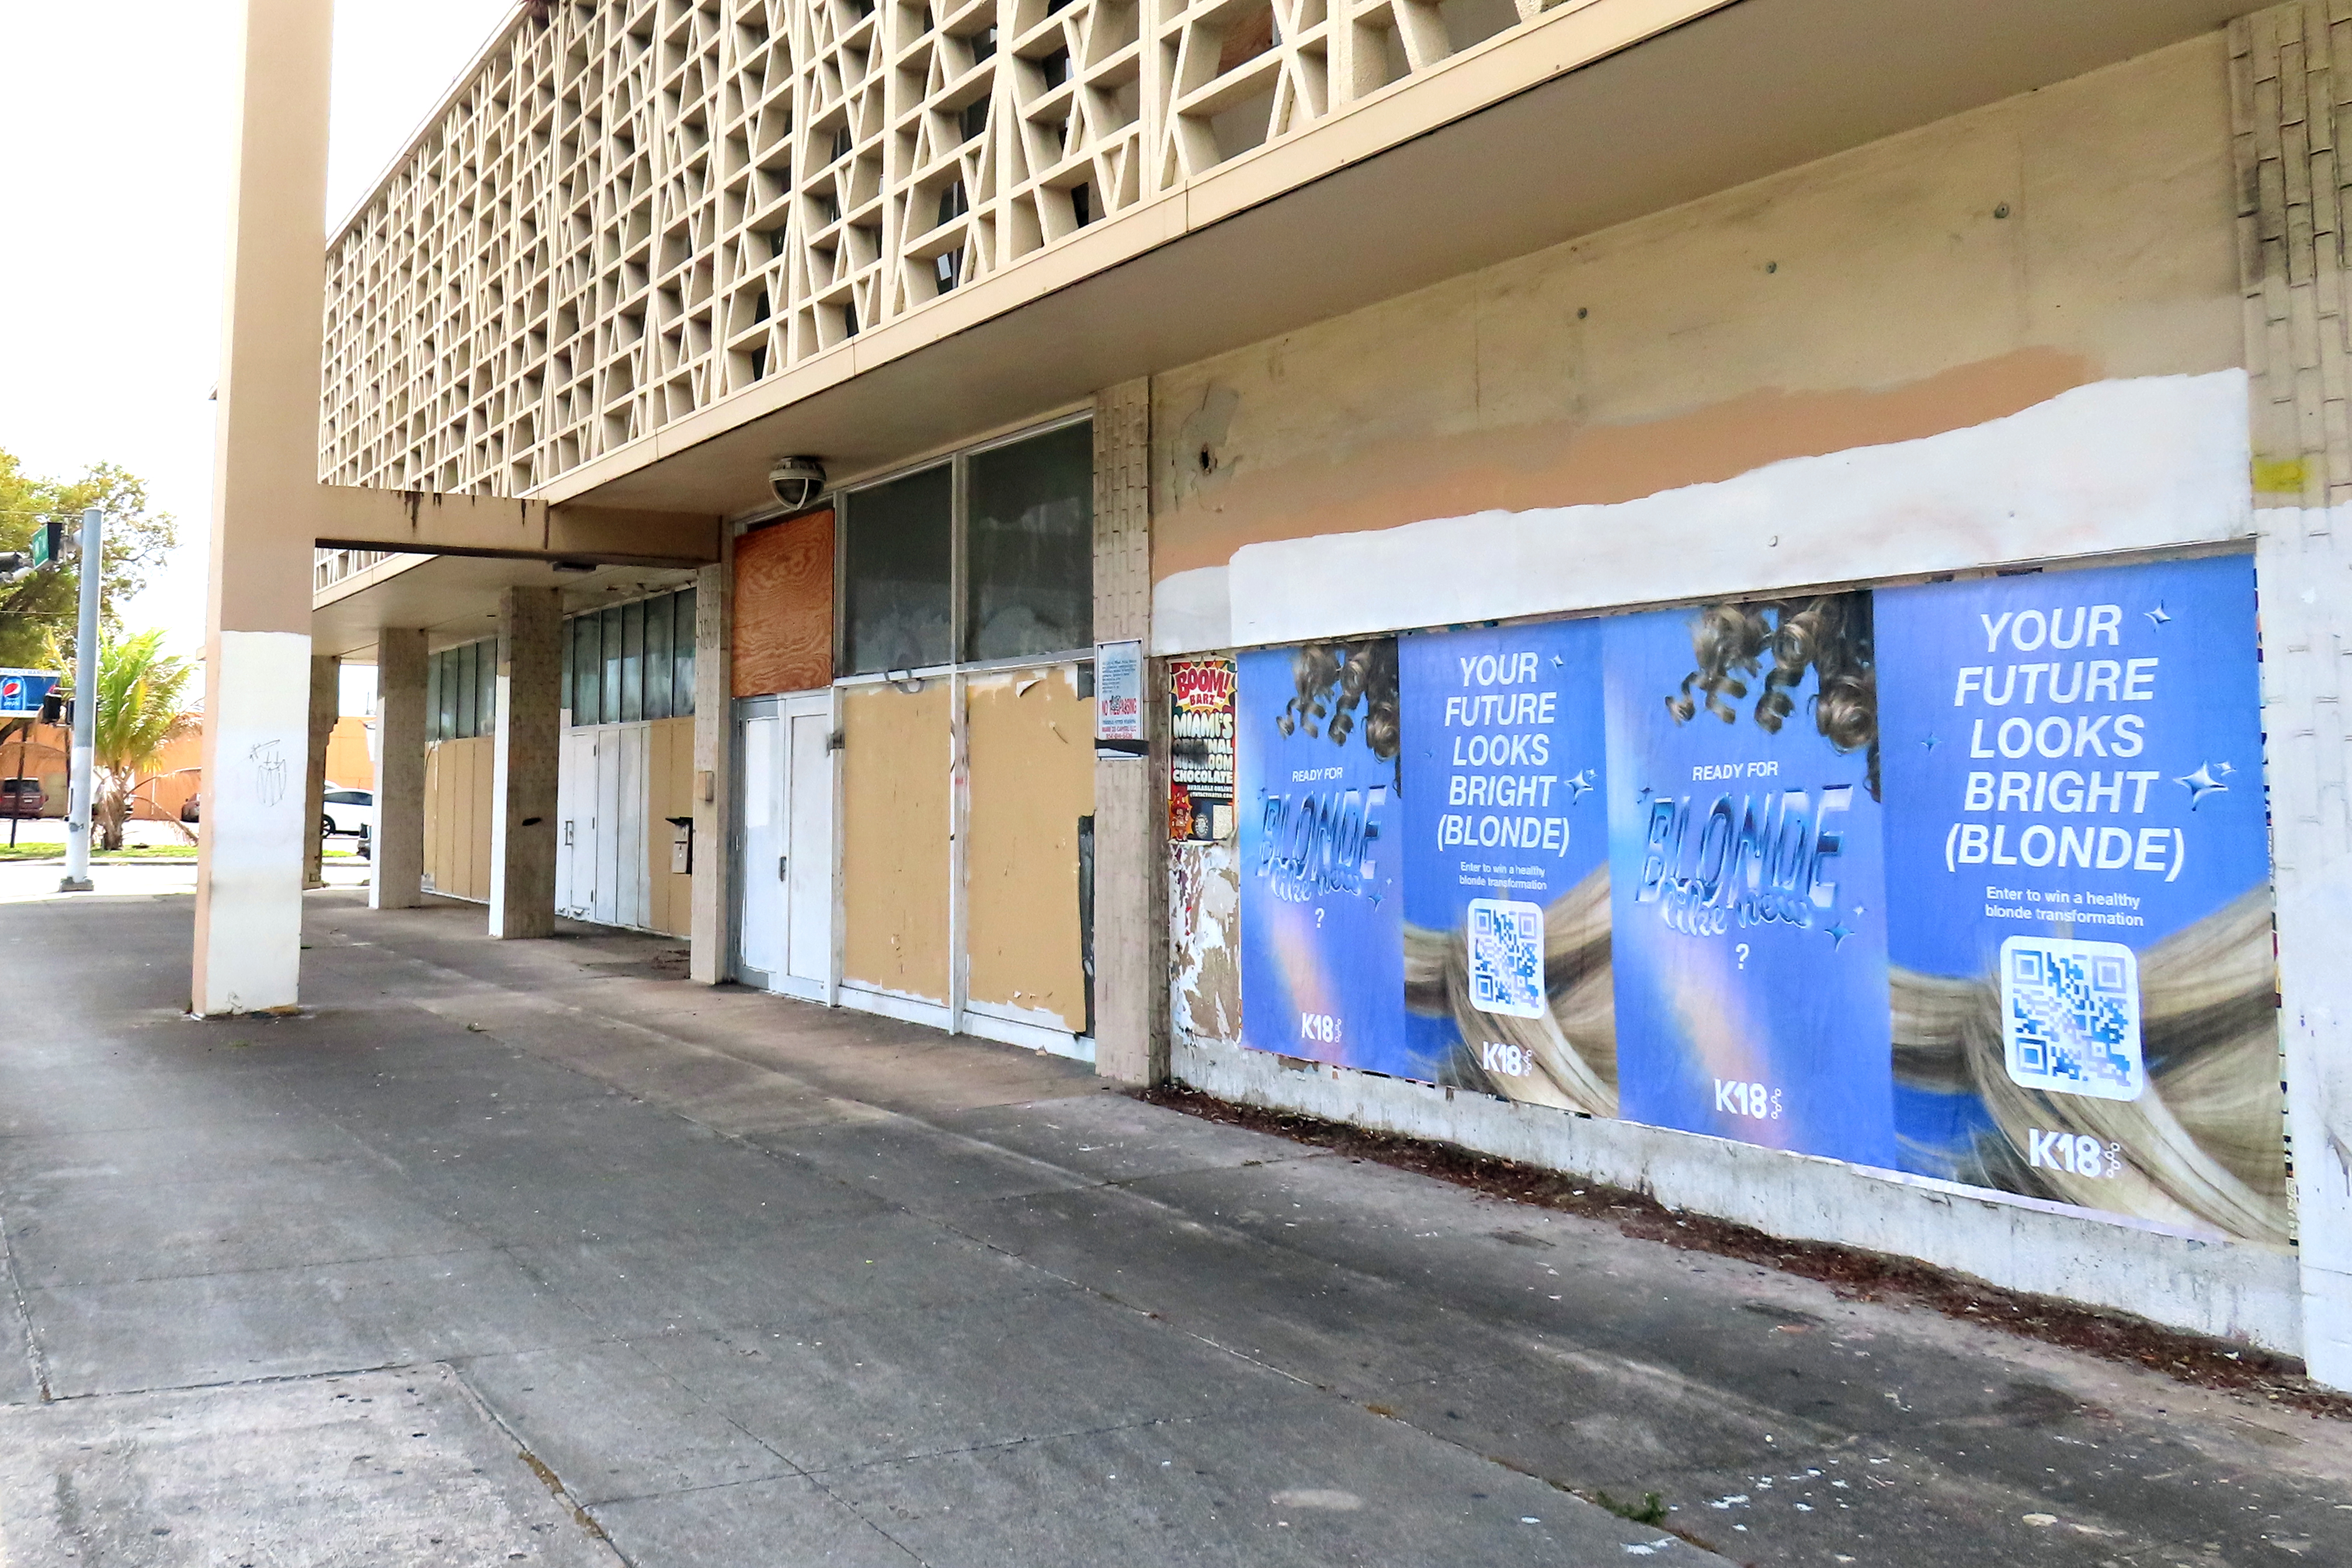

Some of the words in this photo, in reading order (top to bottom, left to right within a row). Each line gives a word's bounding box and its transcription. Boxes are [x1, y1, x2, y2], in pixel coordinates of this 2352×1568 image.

[1980, 604, 2122, 653] YOUR
[1176, 669, 1231, 700] BOOM!
[1460, 652, 1538, 687] YOUR
[1954, 657, 2159, 707] FUTURE
[1190, 693, 1215, 705] BARZ
[1444, 692, 1557, 726] FUTURE
[1173, 712, 1234, 739] MIAMI'S
[1970, 714, 2145, 759] LOOKS
[1453, 733, 1550, 766] LOOKS
[1173, 769, 1234, 784] CHOCOLATE
[1292, 769, 1322, 783] READY
[1324, 767, 1343, 780] FOR
[1692, 764, 1743, 781] READY
[1747, 761, 1778, 777] FOR
[1448, 775, 1558, 807] BRIGHT
[1964, 770, 2159, 813] BRIGHT
[1255, 784, 1387, 881] BLONDE
[1437, 814, 1569, 857] (BLONDE)
[1635, 784, 1853, 909] BLONDE
[1945, 823, 2184, 882] (BLONDE)
[1460, 861, 1481, 872] Enter
[1482, 863, 1491, 872] to
[1493, 864, 1507, 874] win
[1509, 866, 1514, 874] a
[1516, 865, 1545, 878] healthy
[1460, 875, 1486, 886] blonde
[1488, 878, 1547, 890] transformation
[1986, 886, 2023, 901] Enter
[2026, 888, 2041, 902] to
[2045, 890, 2069, 903] win
[2074, 893, 2083, 904] a
[2086, 891, 2141, 910] healthy
[1315, 908, 1325, 929] ?
[1985, 904, 2032, 919] blonde
[2035, 908, 2144, 926] transformation
[1735, 943, 1750, 970] ?
[1301, 1012, 1334, 1043] K18
[1483, 1041, 1522, 1077] K18
[1715, 1078, 1767, 1119] K18
[2029, 1128, 2101, 1178] K18
